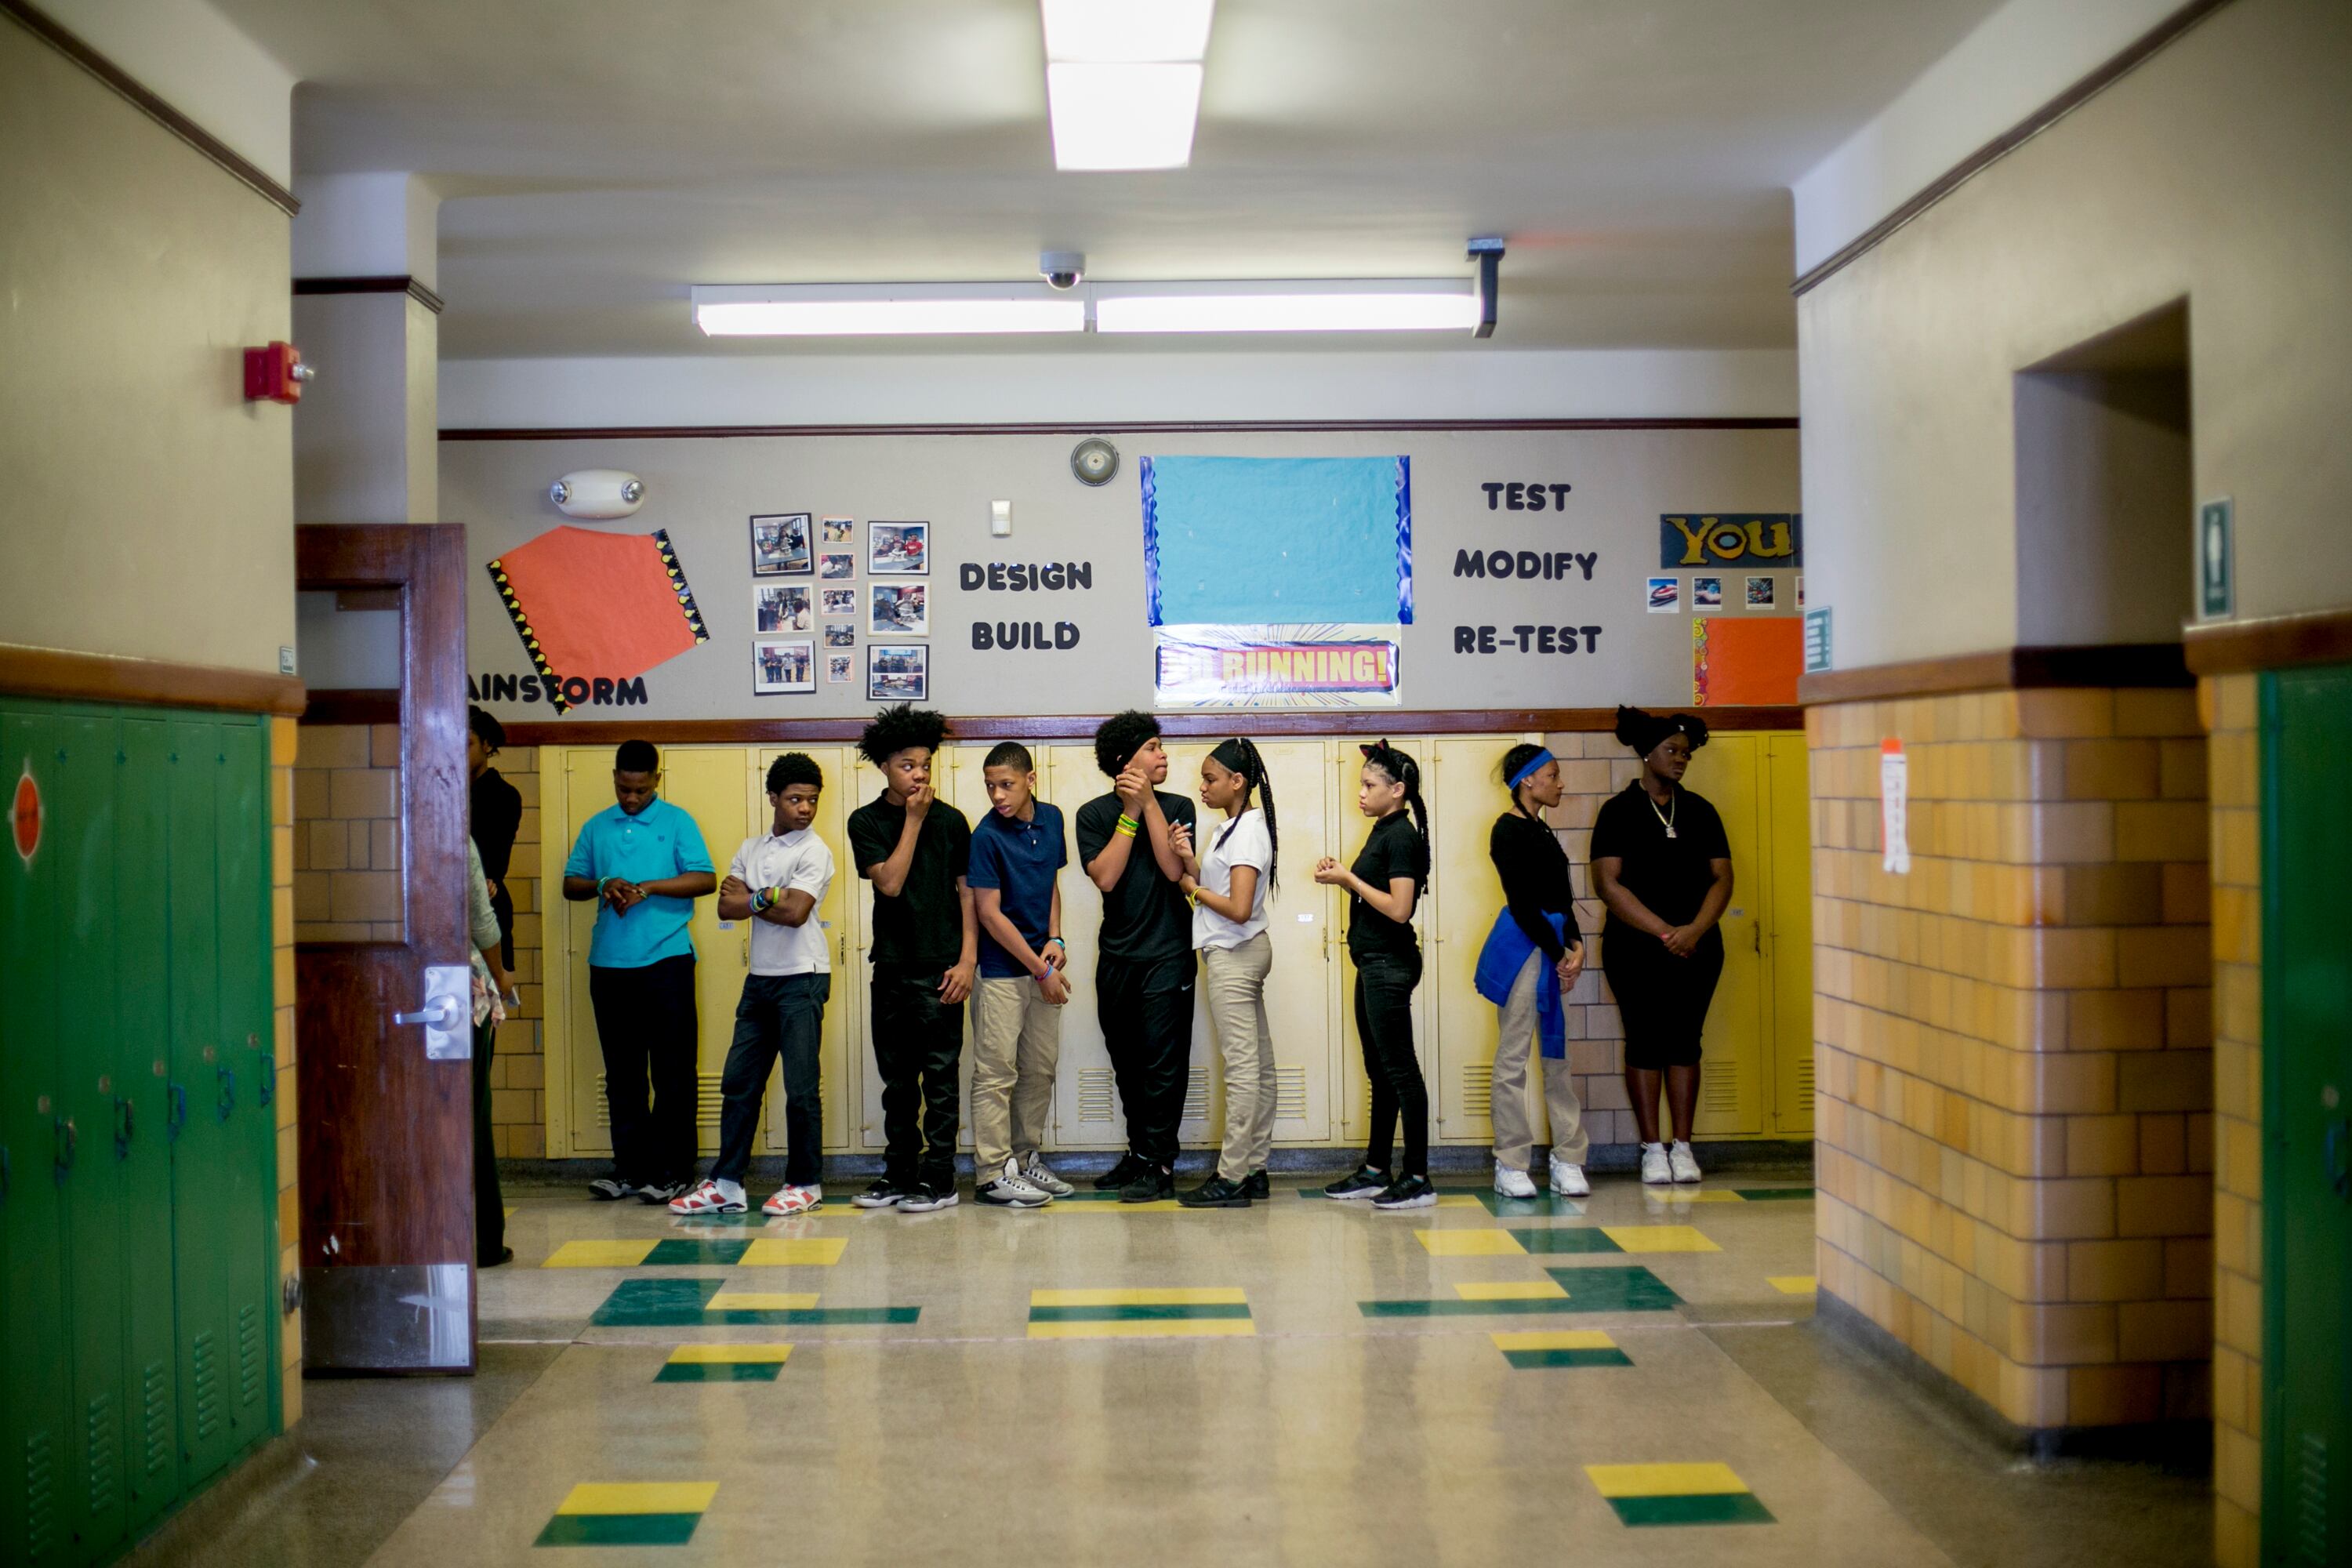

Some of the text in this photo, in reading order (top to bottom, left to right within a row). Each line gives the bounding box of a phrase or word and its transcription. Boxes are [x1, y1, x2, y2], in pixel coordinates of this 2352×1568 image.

[1481, 482, 1571, 512] TEST
[960, 561, 1092, 592] DESIGN
[1454, 549, 1598, 581] MODIFY
[972, 622, 1080, 650] BUILD
[1454, 625, 1602, 655] RE-TEST
[1222, 650, 1388, 681] RUNNING!
